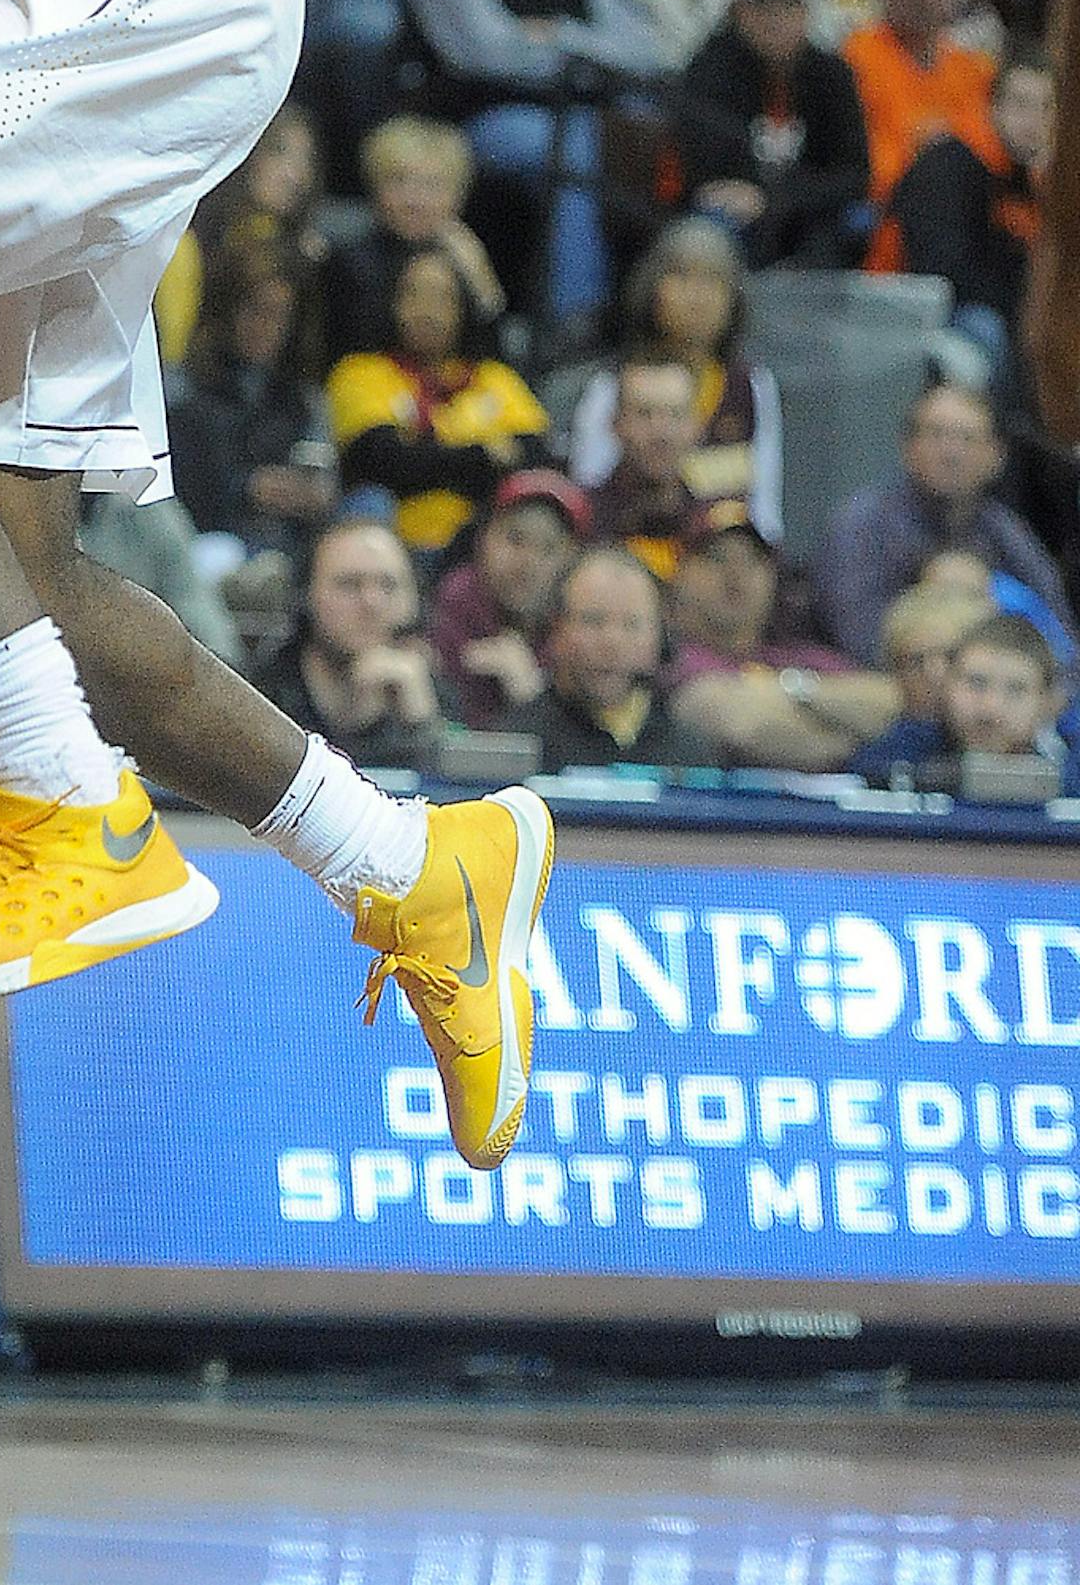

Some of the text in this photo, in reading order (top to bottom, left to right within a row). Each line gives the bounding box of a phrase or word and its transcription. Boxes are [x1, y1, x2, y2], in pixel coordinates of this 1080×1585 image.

[397, 902, 1080, 1047] ANFORD
[383, 1066, 1077, 1157] OTHOPEDIC
[277, 1147, 706, 1231] SPORTS
